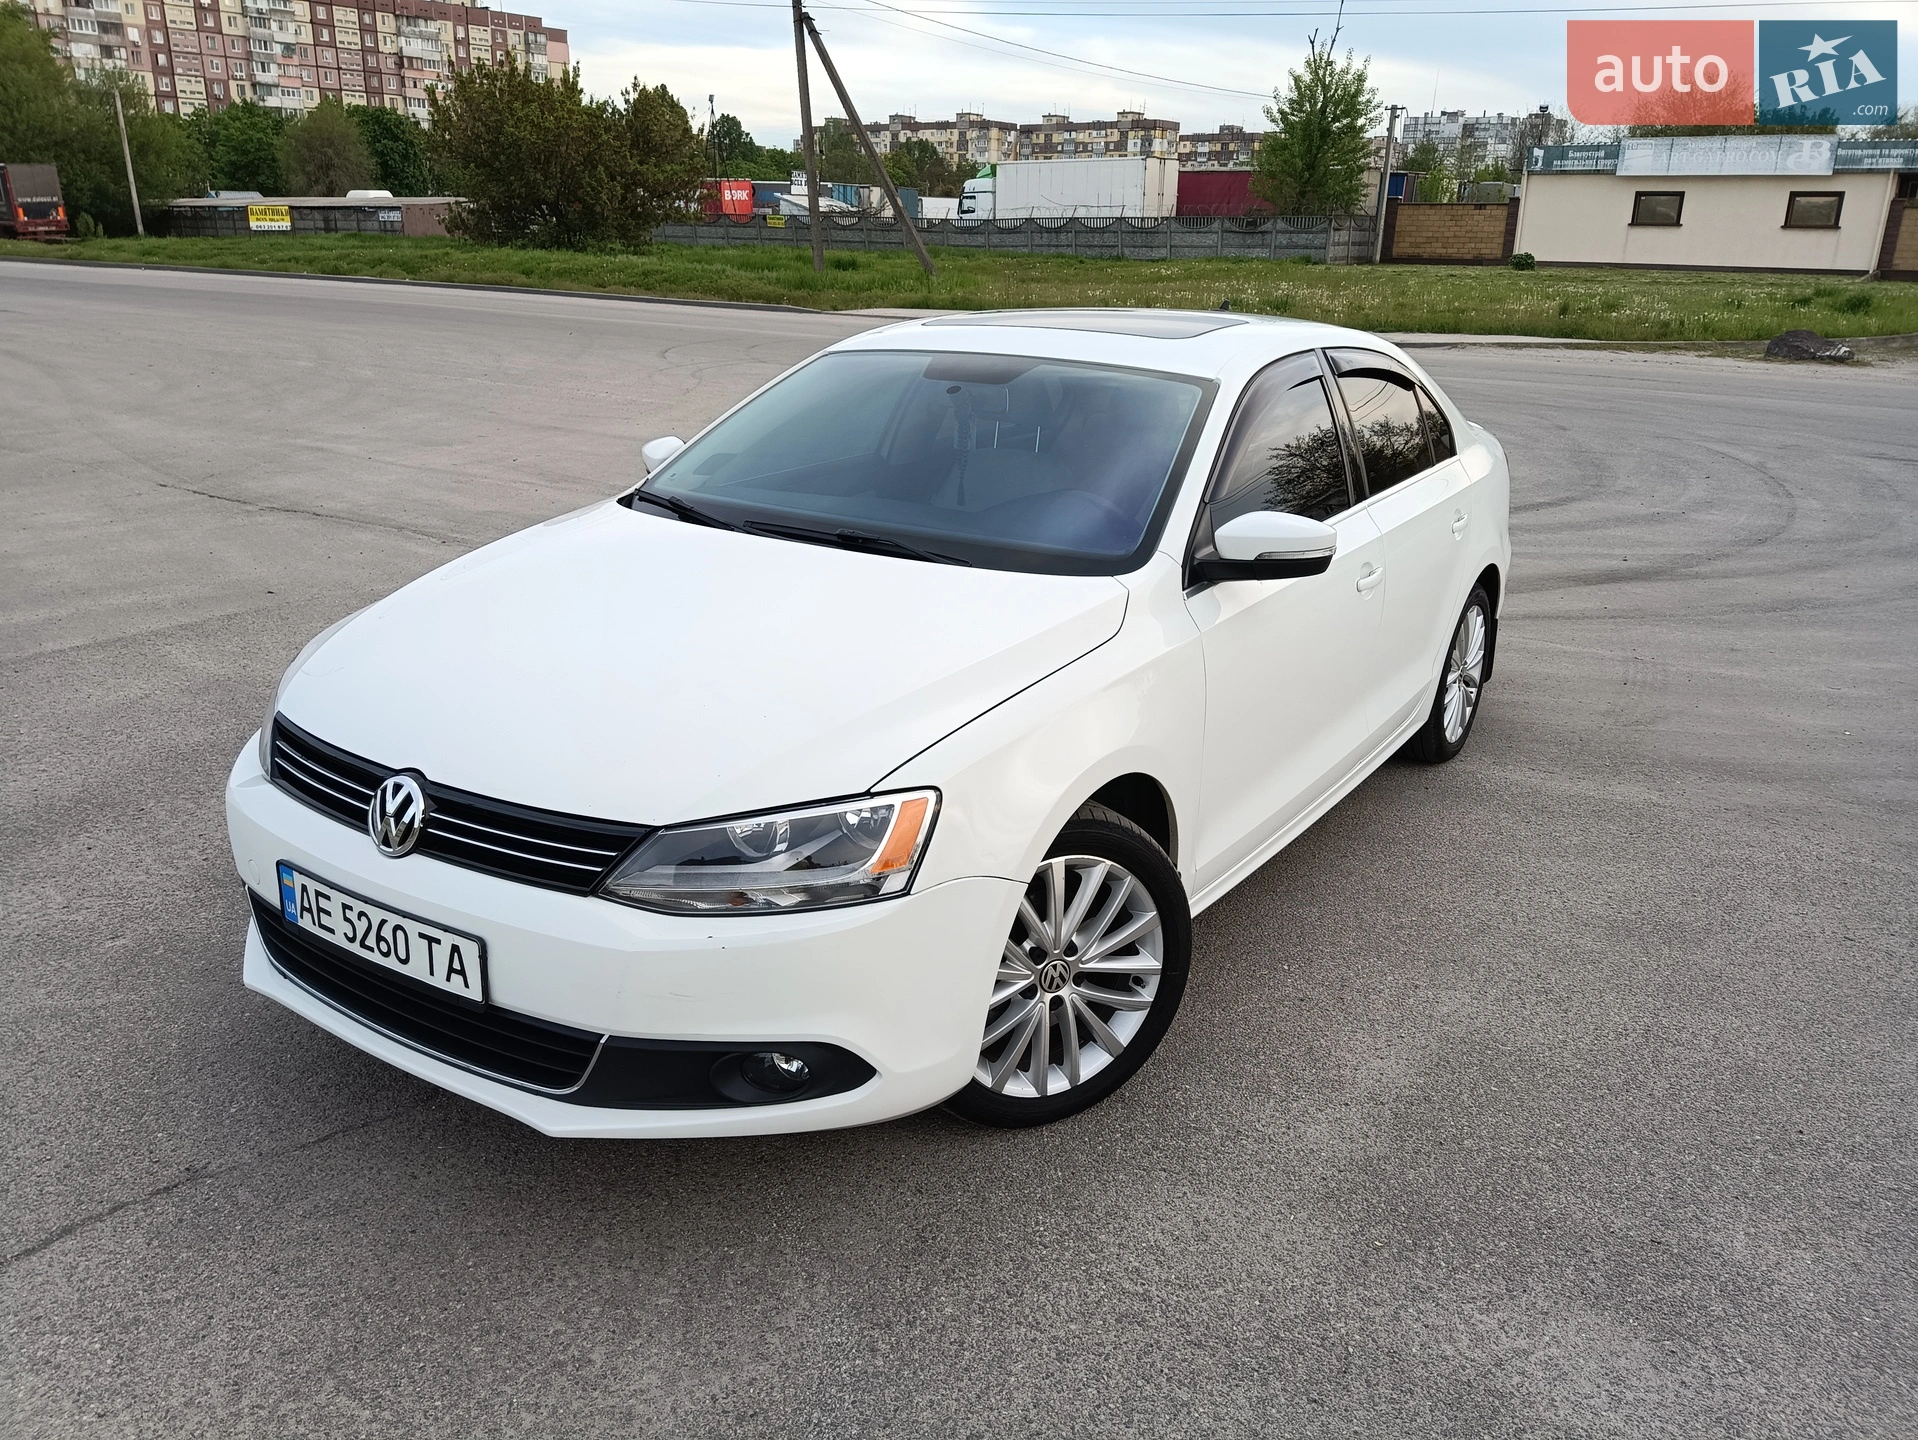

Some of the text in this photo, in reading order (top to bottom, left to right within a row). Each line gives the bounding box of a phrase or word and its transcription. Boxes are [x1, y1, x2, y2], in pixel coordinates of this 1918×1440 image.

[285, 898, 297, 916] UA
[299, 882, 470, 989] AE 5260 TA
